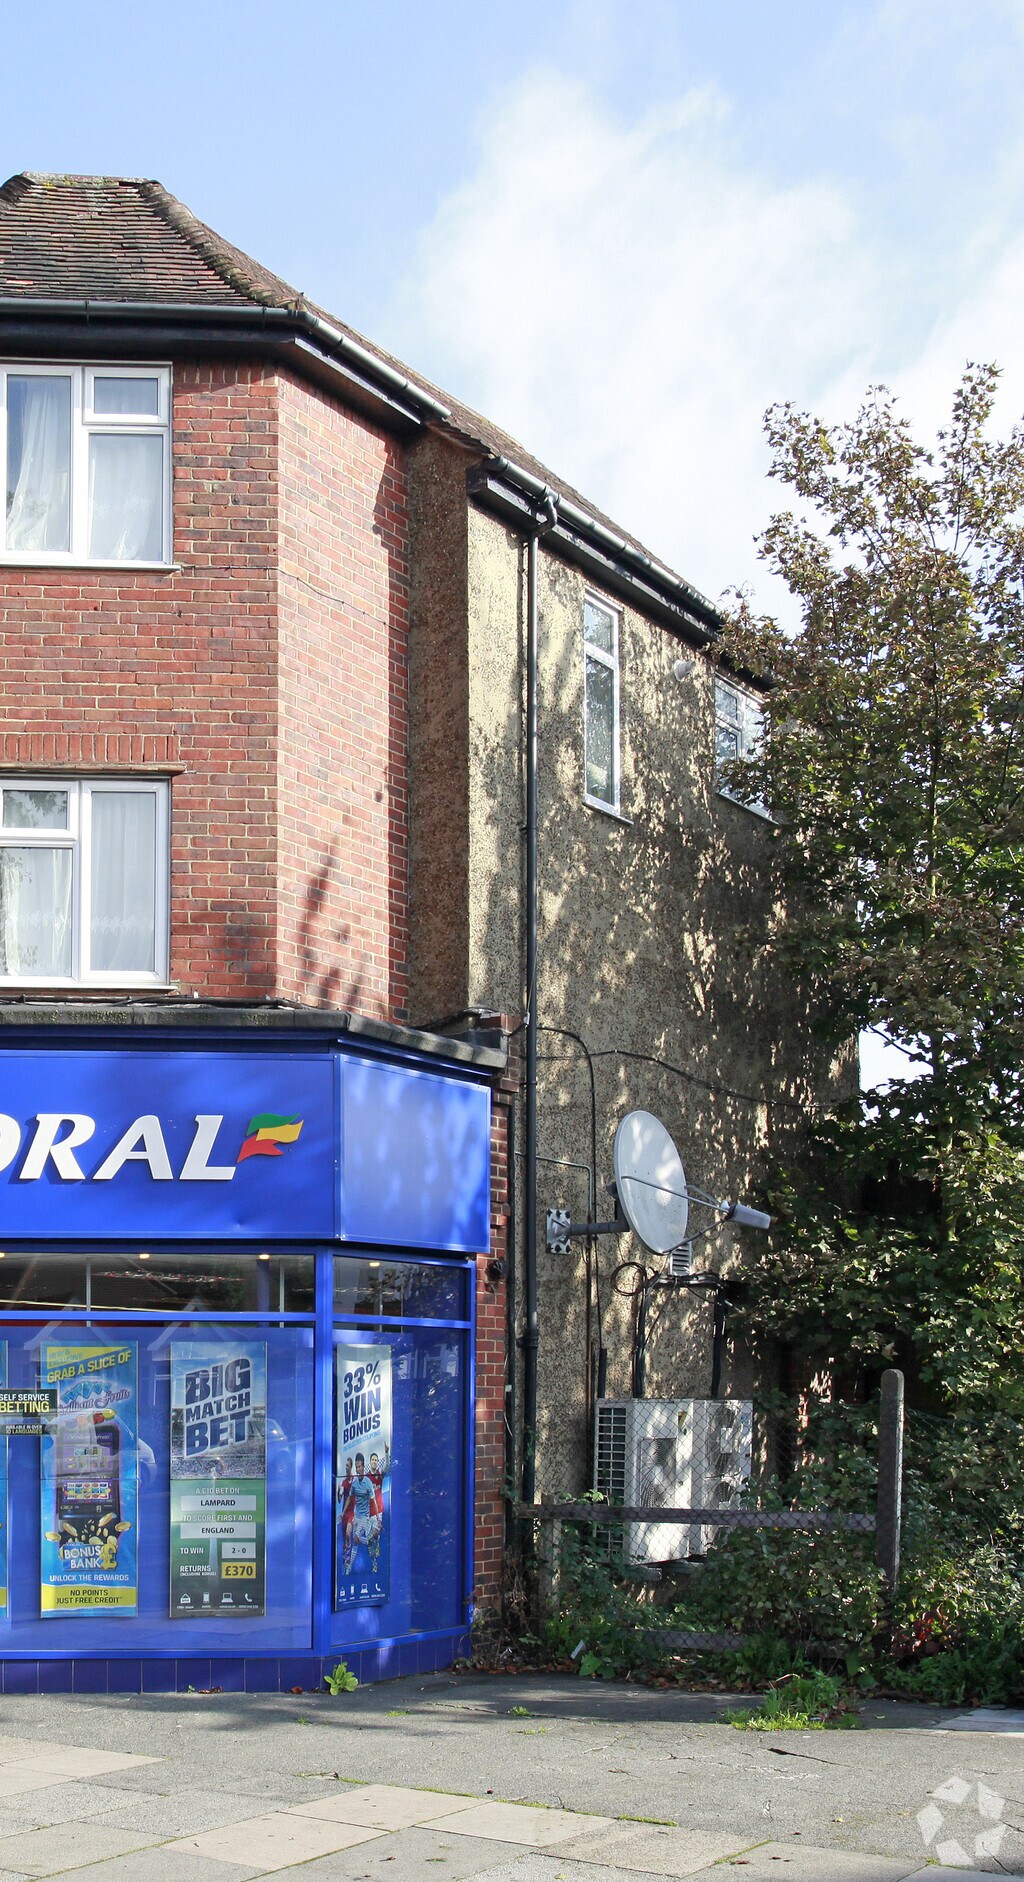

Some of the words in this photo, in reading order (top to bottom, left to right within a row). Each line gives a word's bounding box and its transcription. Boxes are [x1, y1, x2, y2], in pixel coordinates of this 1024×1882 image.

[47, 1367, 75, 1383] GRAB
[78, 1365, 85, 1375] A
[87, 1357, 115, 1373] SLICE
[118, 1350, 131, 1363] OF
[186, 1358, 251, 1405] BIG
[343, 1360, 381, 1399] 33%
[186, 1392, 251, 1423] MATCH
[343, 1387, 381, 1426] WIN
[186, 1409, 251, 1456] BET
[343, 1413, 381, 1444] BONUS
[200, 1499, 236, 1507] LAMPARD
[64, 1545, 101, 1560] BONUS
[70, 1558, 101, 1569] BANK
[225, 1565, 253, 1576] £370
